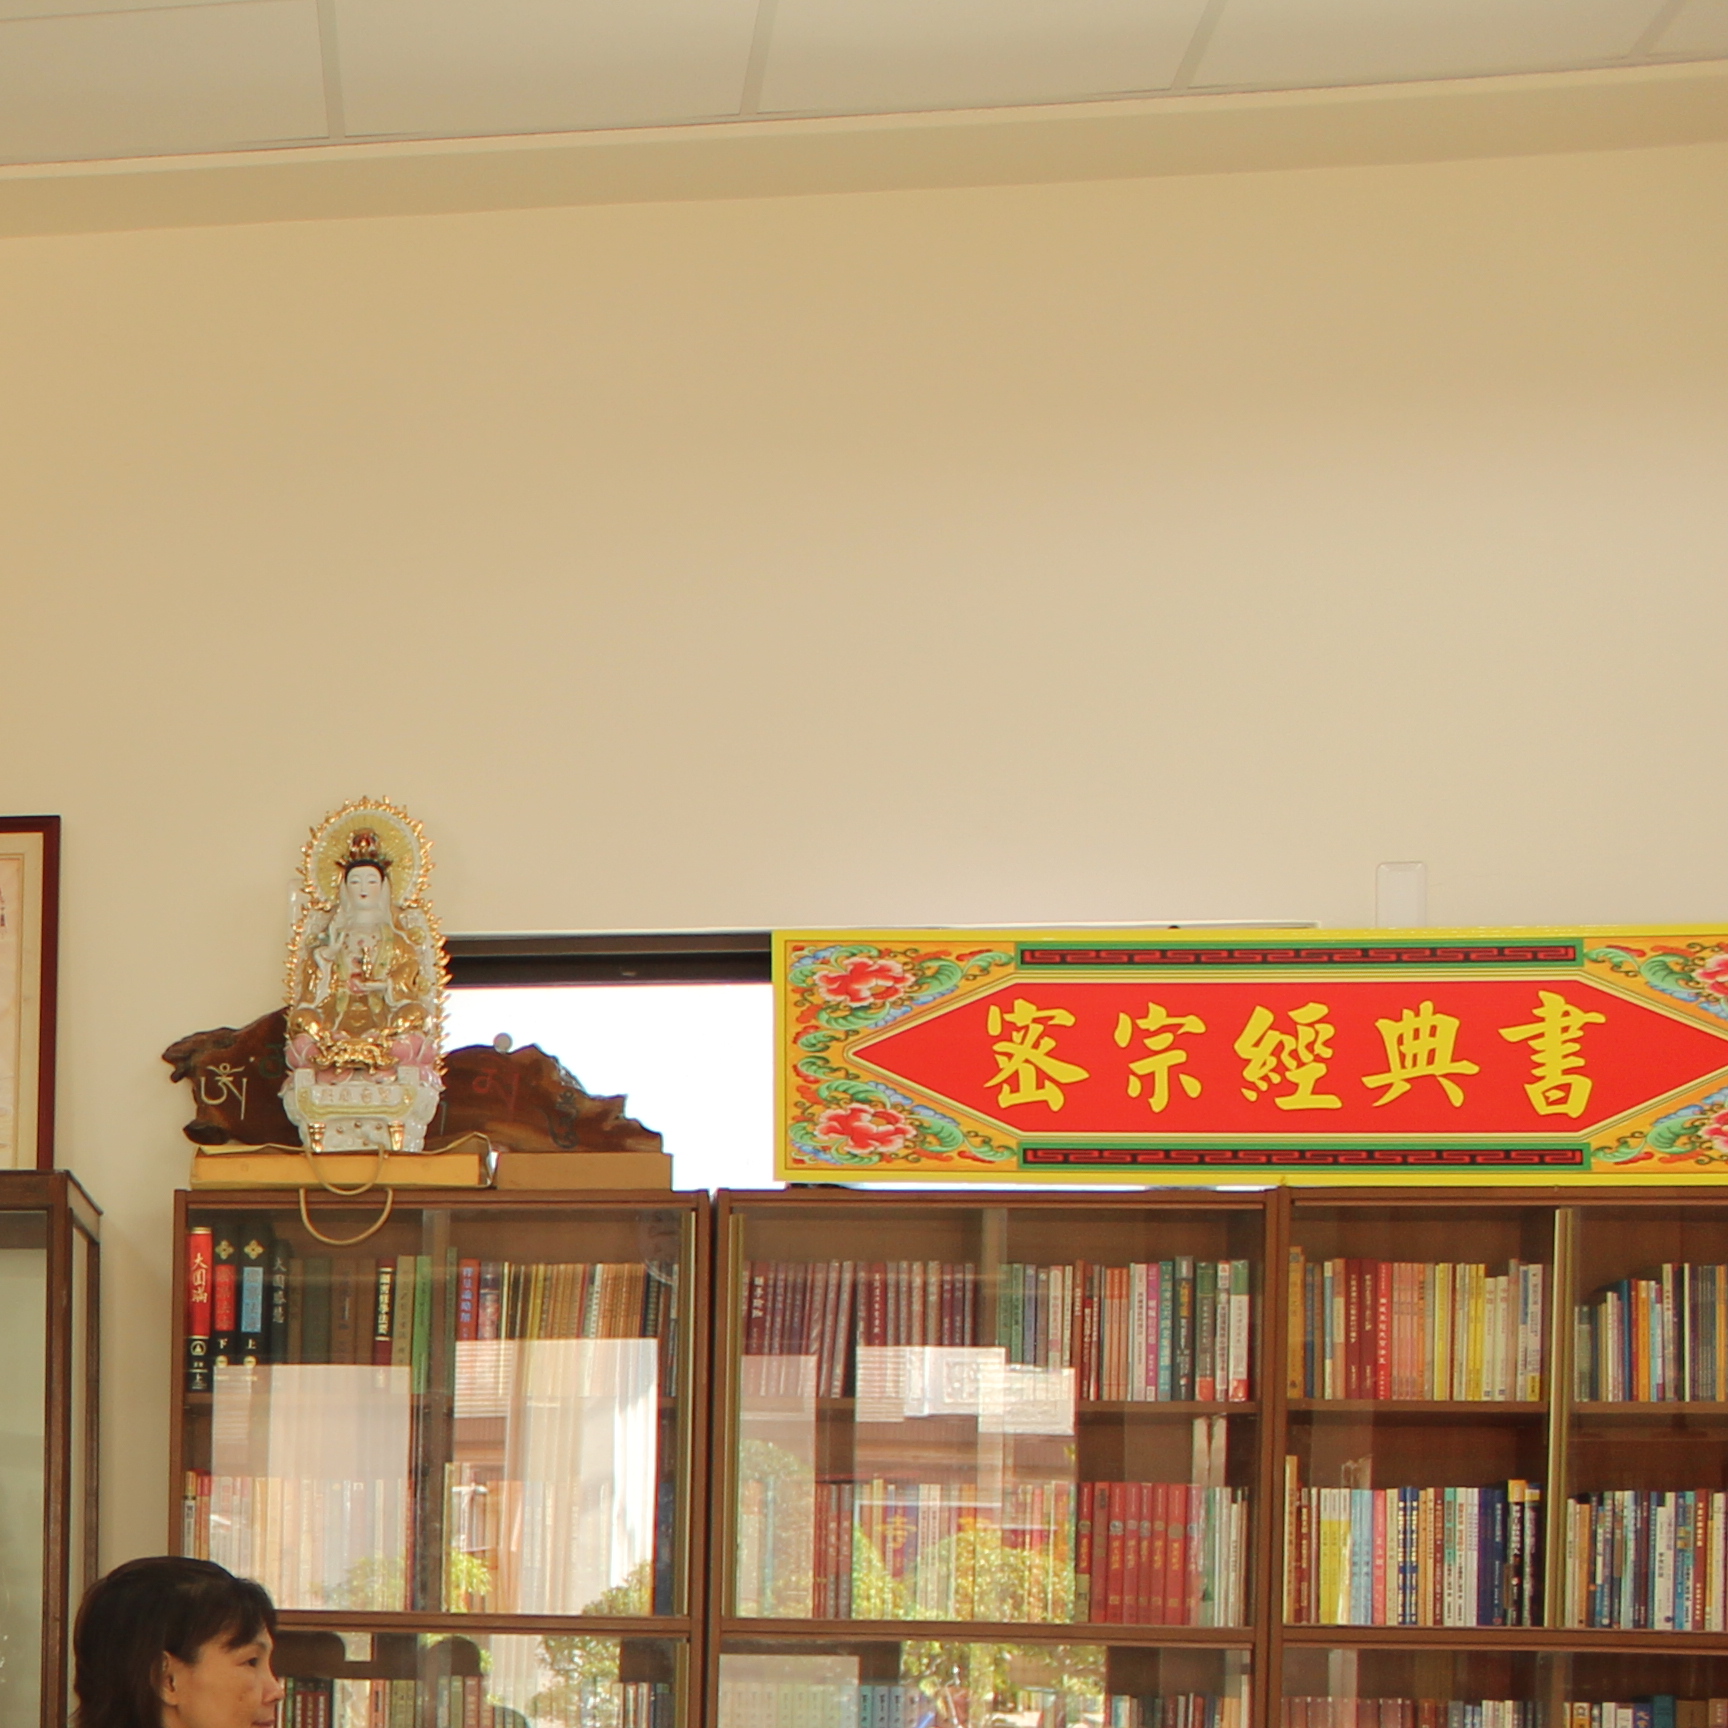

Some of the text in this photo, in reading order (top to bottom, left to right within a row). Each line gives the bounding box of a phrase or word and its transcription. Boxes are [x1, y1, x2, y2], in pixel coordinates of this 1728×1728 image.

[981, 989, 1607, 1119] 密宗經典書
